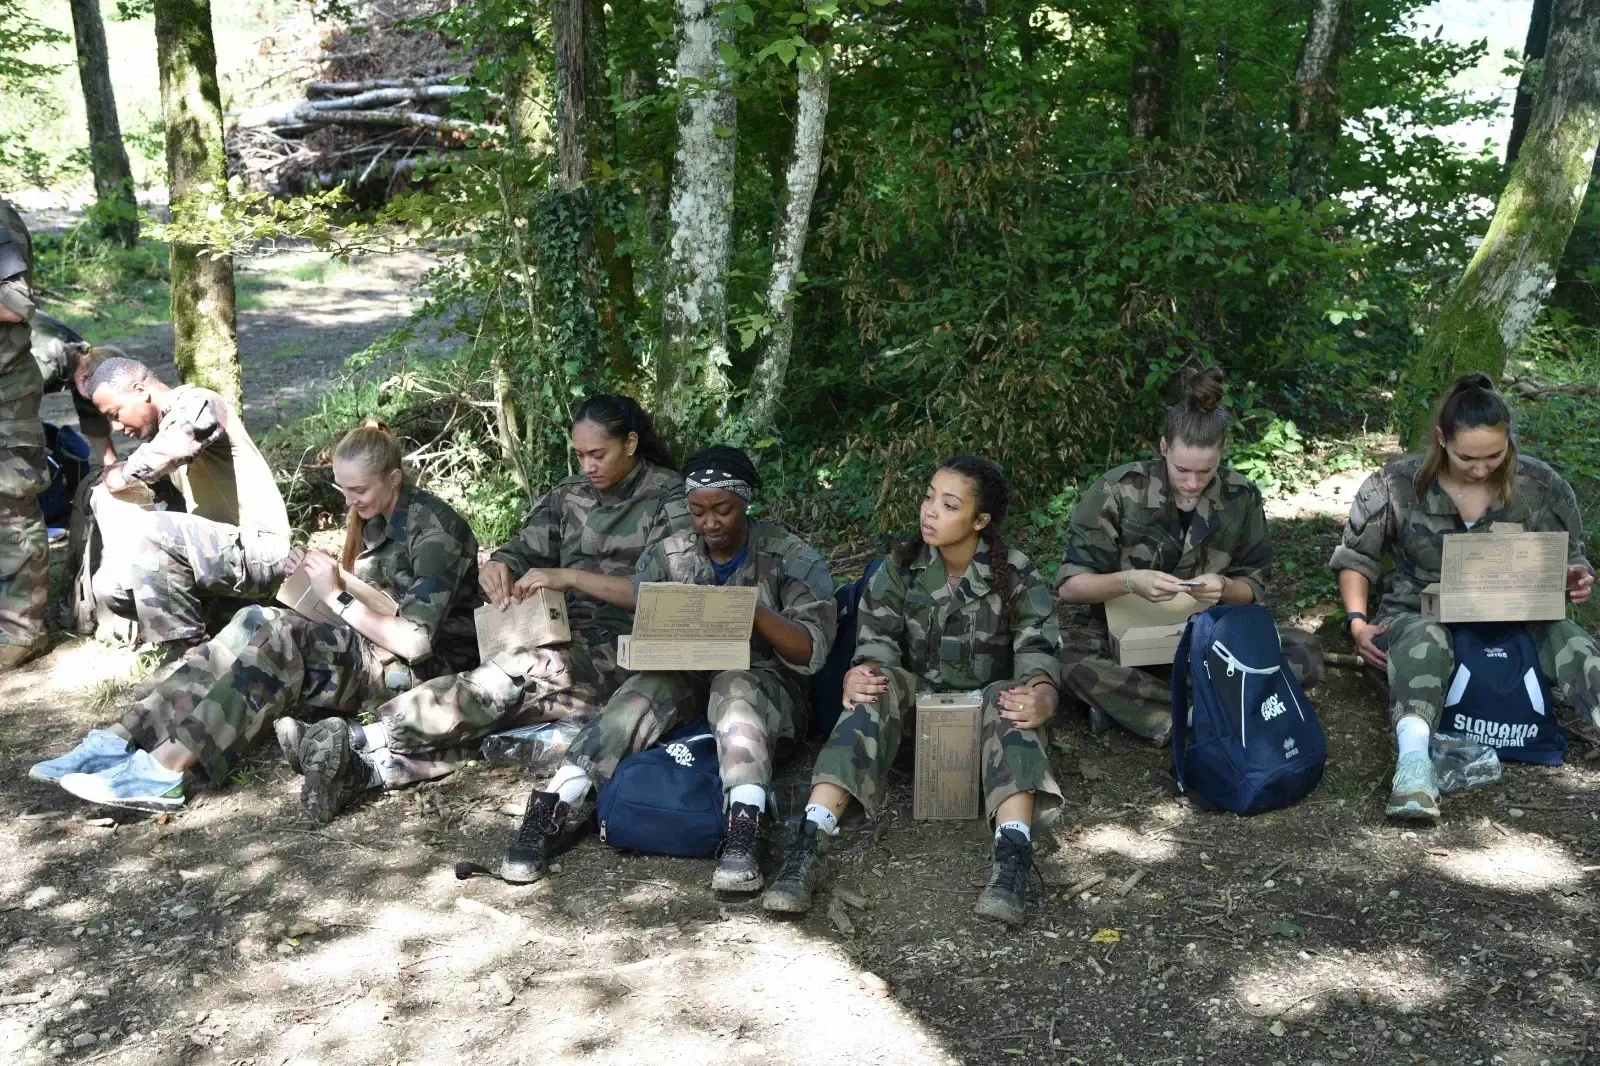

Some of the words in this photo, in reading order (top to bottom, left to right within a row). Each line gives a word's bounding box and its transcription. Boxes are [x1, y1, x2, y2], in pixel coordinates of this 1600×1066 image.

[1262, 701, 1287, 721] SPORT
[1453, 713, 1539, 738] SLOVAKIA
[1466, 732, 1525, 748] volleyball
